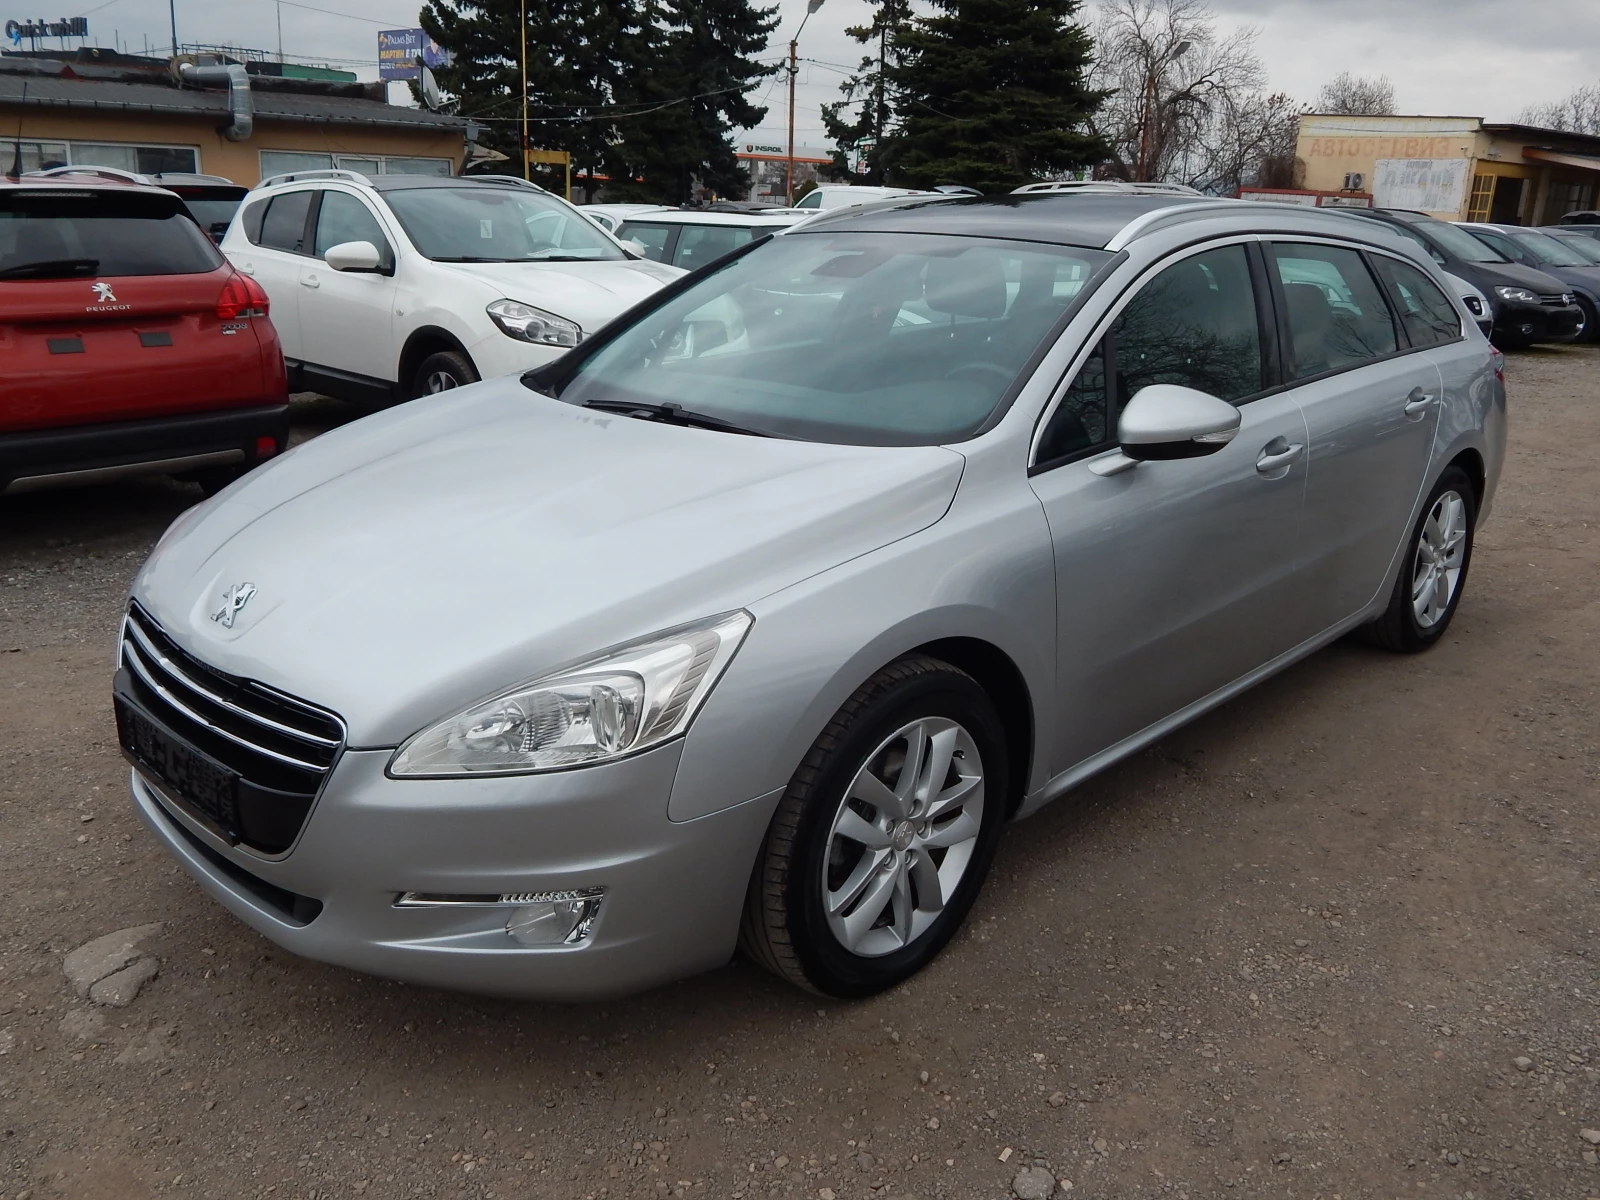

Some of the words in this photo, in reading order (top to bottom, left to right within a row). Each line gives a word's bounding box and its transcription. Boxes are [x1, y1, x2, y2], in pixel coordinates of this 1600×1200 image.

[5, 18, 50, 46] Quick
[380, 50, 405, 59] МАРТИН
[1309, 137, 1450, 158] АВТОСЕРВИЗ
[85, 304, 131, 312] PEUGEOT
